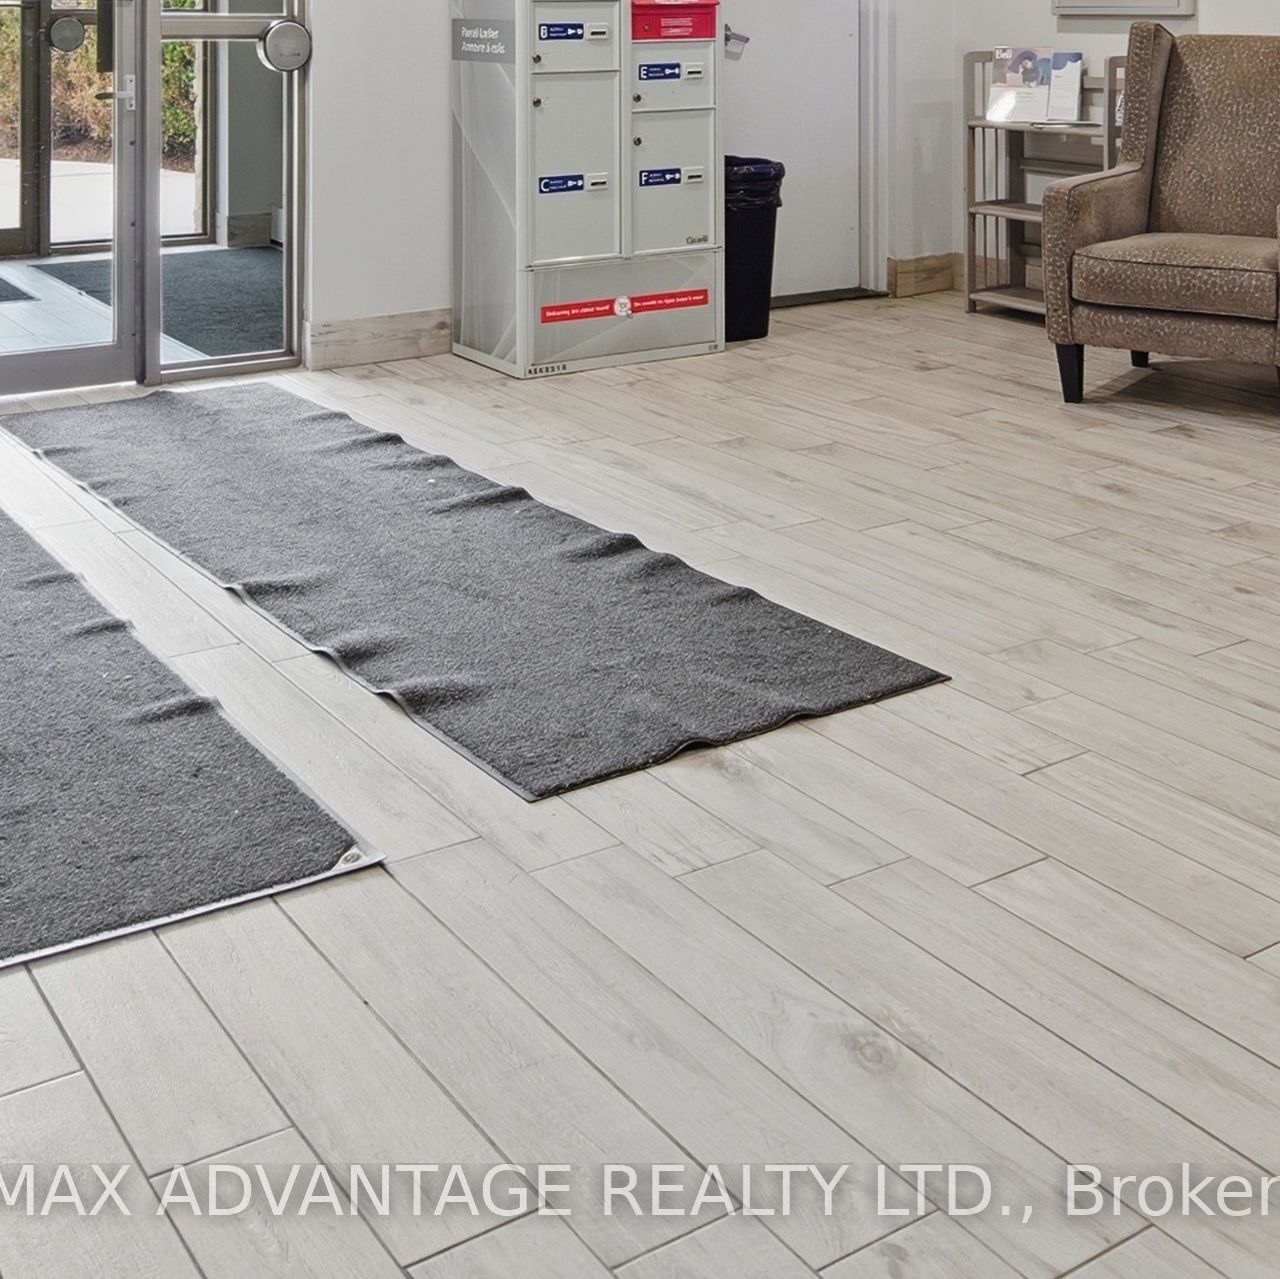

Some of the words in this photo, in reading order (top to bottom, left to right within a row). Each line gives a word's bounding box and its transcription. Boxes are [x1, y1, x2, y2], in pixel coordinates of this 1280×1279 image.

[540, 25, 548, 39] B
[640, 66, 648, 79] E
[641, 172, 649, 185] F
[540, 179, 550, 192] C
